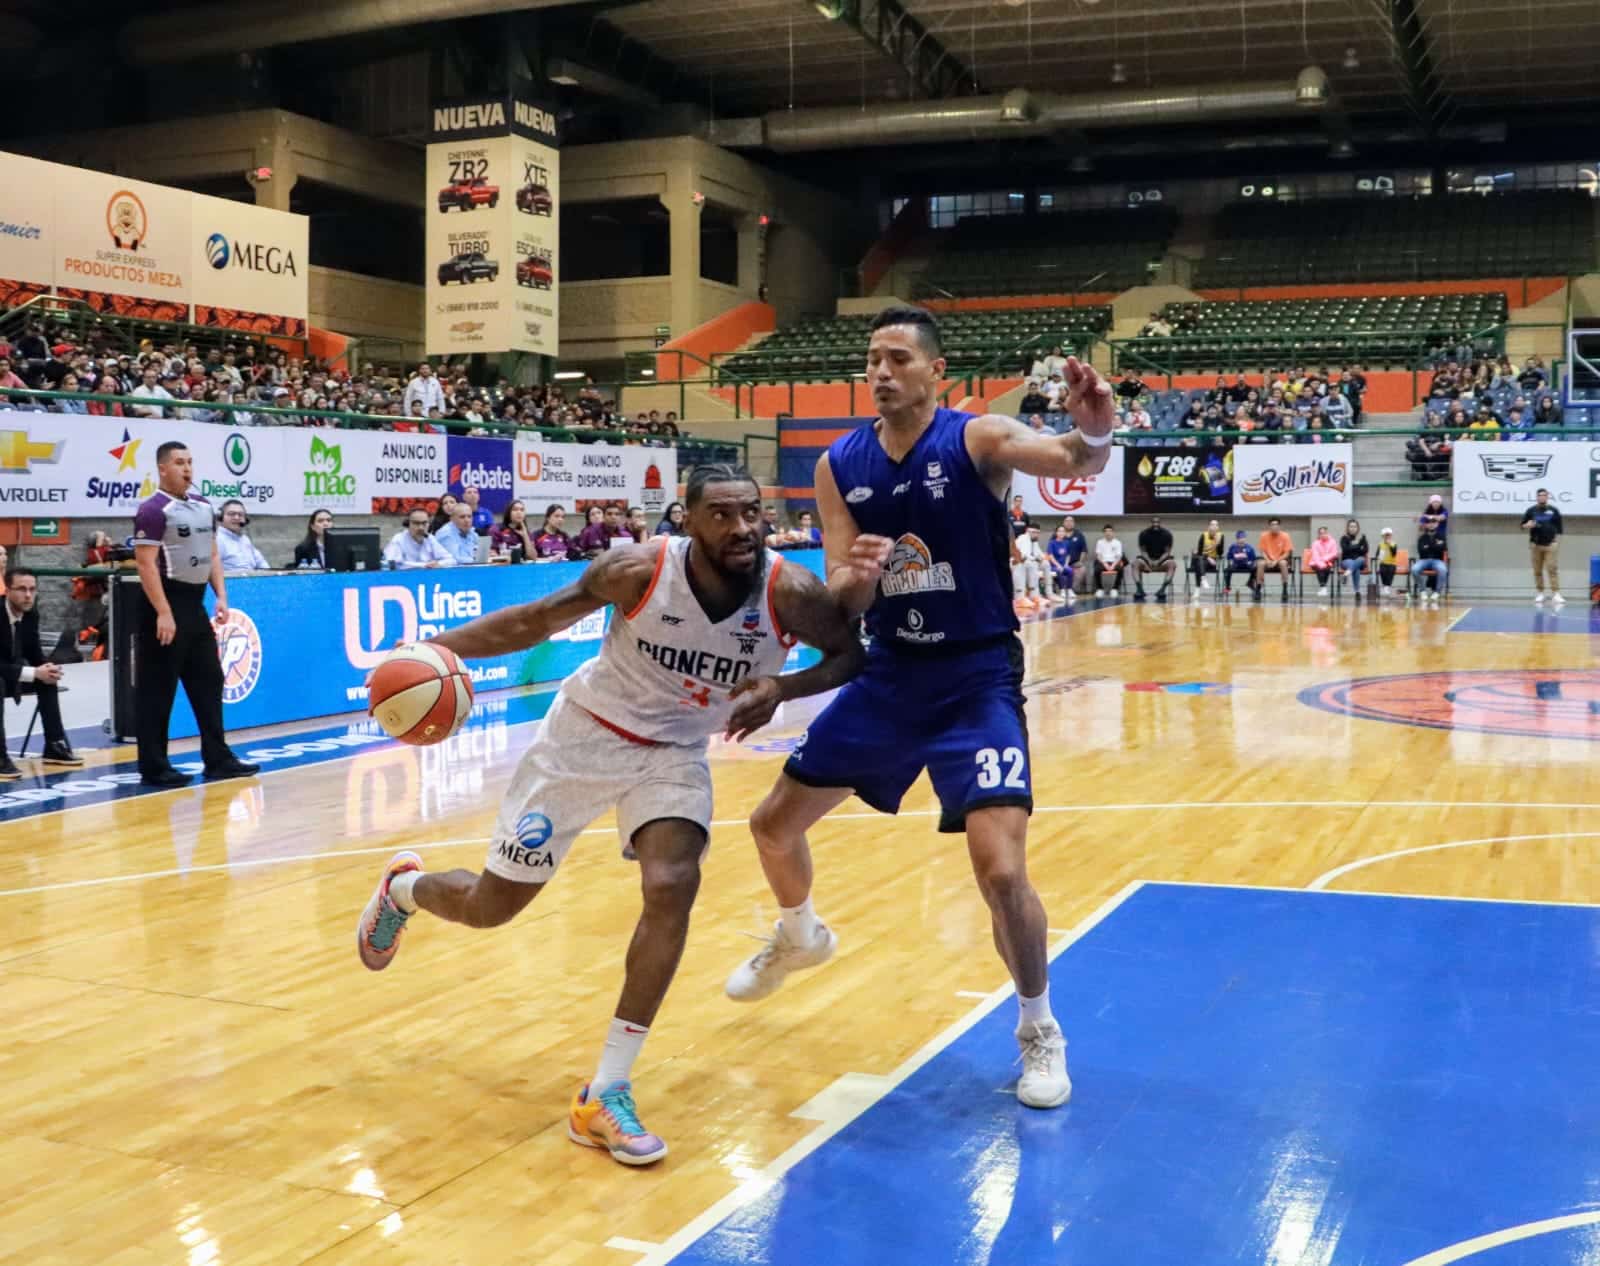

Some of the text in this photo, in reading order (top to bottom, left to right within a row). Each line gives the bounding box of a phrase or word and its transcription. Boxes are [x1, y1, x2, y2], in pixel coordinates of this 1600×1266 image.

[434, 102, 505, 131] NUEVA
[515, 101, 557, 136] NUEVA
[95, 248, 122, 263] SUPER
[232, 241, 297, 277] MEGA
[448, 240, 490, 257] TURBO
[64, 257, 183, 288] PRODUCTOS MEZA
[382, 443, 437, 460] ANUNCIO
[581, 455, 622, 468] ANUNCIO
[375, 467, 443, 484] DISPONIBLE
[461, 462, 512, 489] debate
[1153, 455, 1196, 476] T88
[201, 479, 275, 502] DieselCargo
[304, 471, 356, 496] mac
[577, 474, 627, 488] DISPONIBLE
[1261, 465, 1297, 496] Roll
[418, 583, 482, 621] Línea
[975, 746, 1026, 789] 32
[498, 839, 554, 868] MEGA
